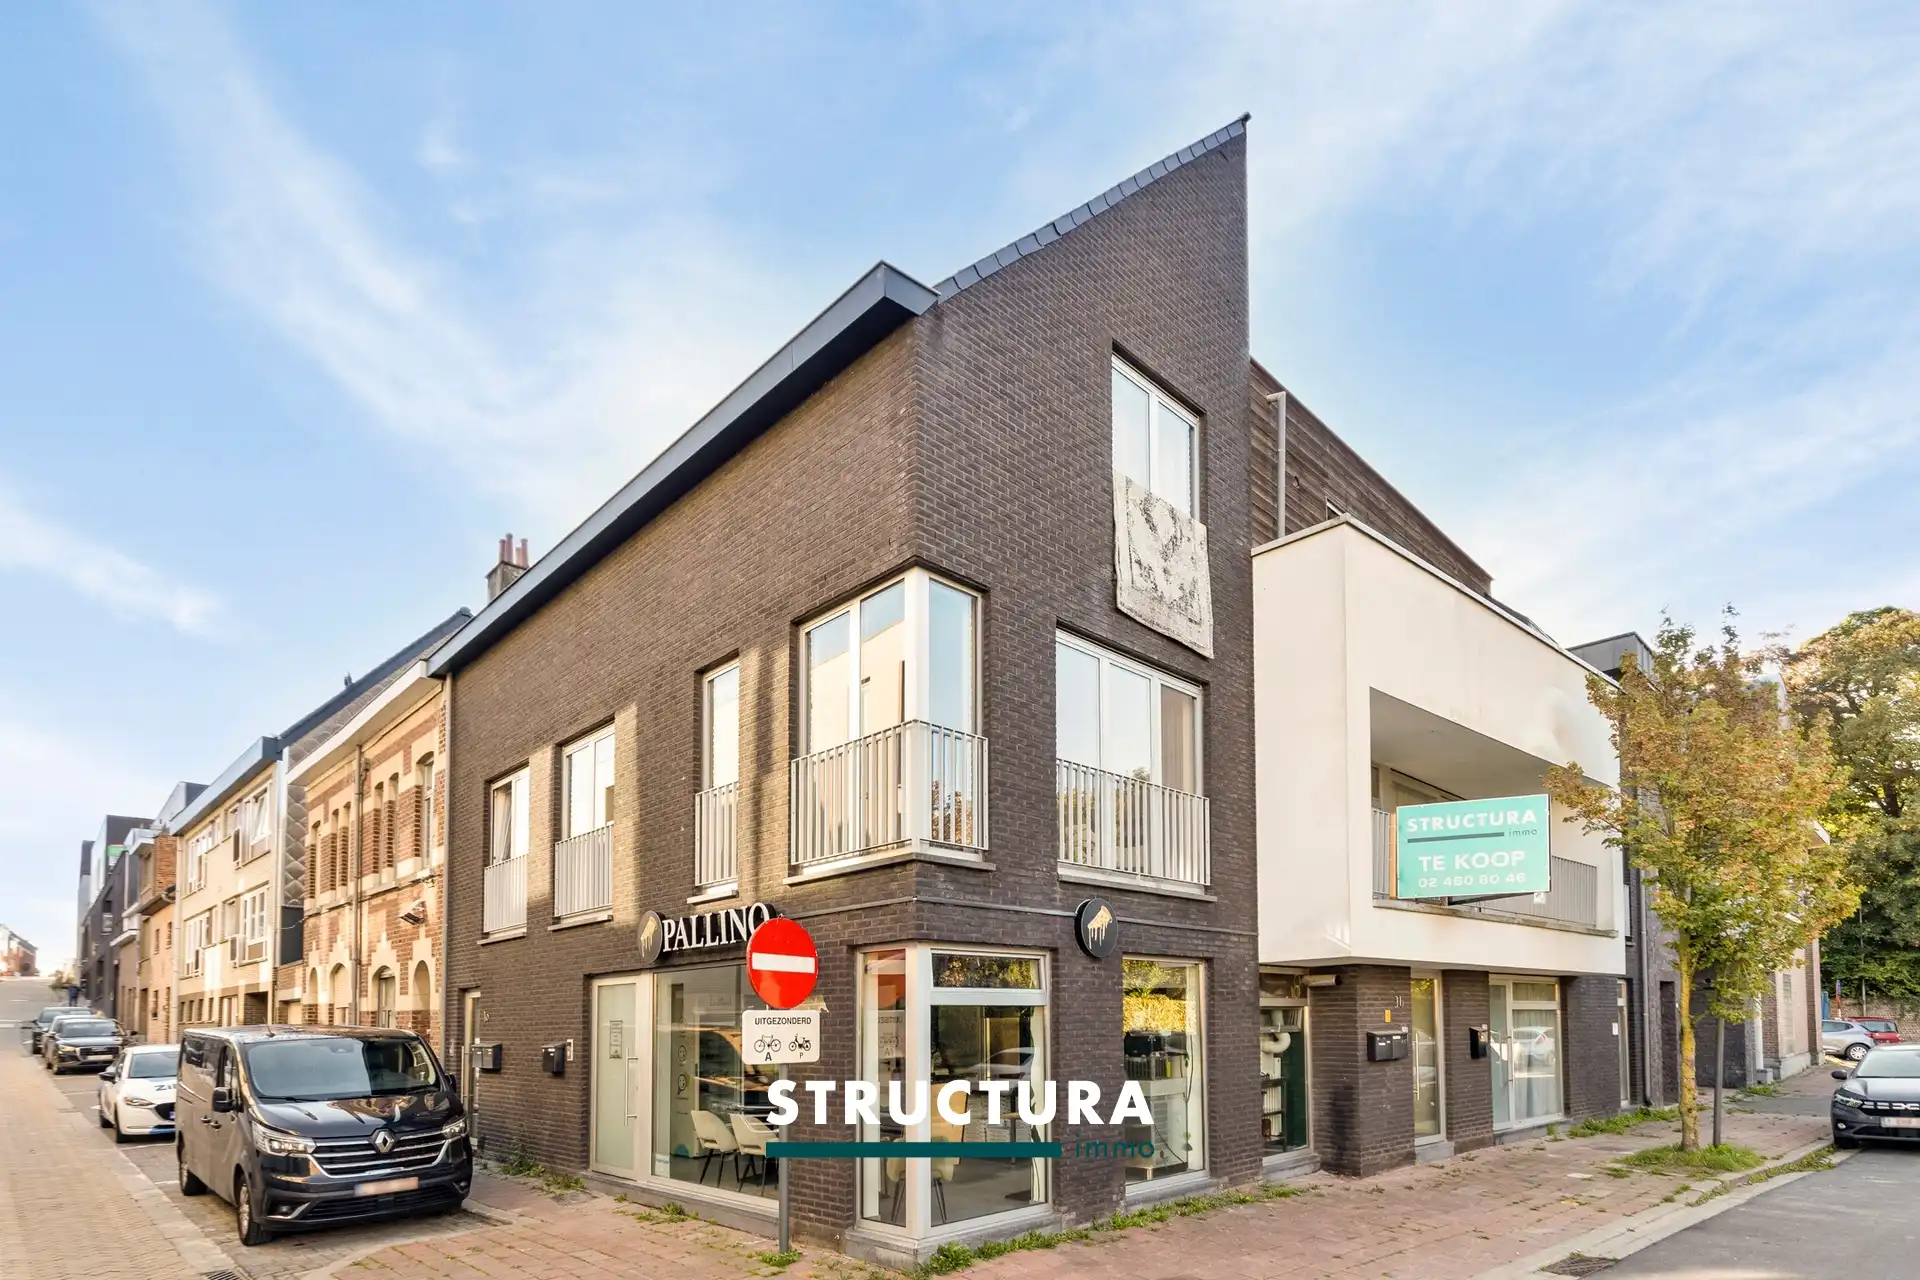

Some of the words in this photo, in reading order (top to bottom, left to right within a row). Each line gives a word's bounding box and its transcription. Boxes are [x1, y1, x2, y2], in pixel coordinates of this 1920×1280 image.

[1408, 810, 1537, 831] STRUCTURA
[1509, 829, 1538, 837] immo
[1419, 855, 1446, 871] TE
[1455, 851, 1525, 869] KOOP
[1418, 877, 1438, 888] 02
[1505, 871, 1527, 883] 46
[661, 902, 770, 953] PALLINO
[754, 1016, 812, 1025] UITGEZONDERD
[764, 1051, 772, 1062] A
